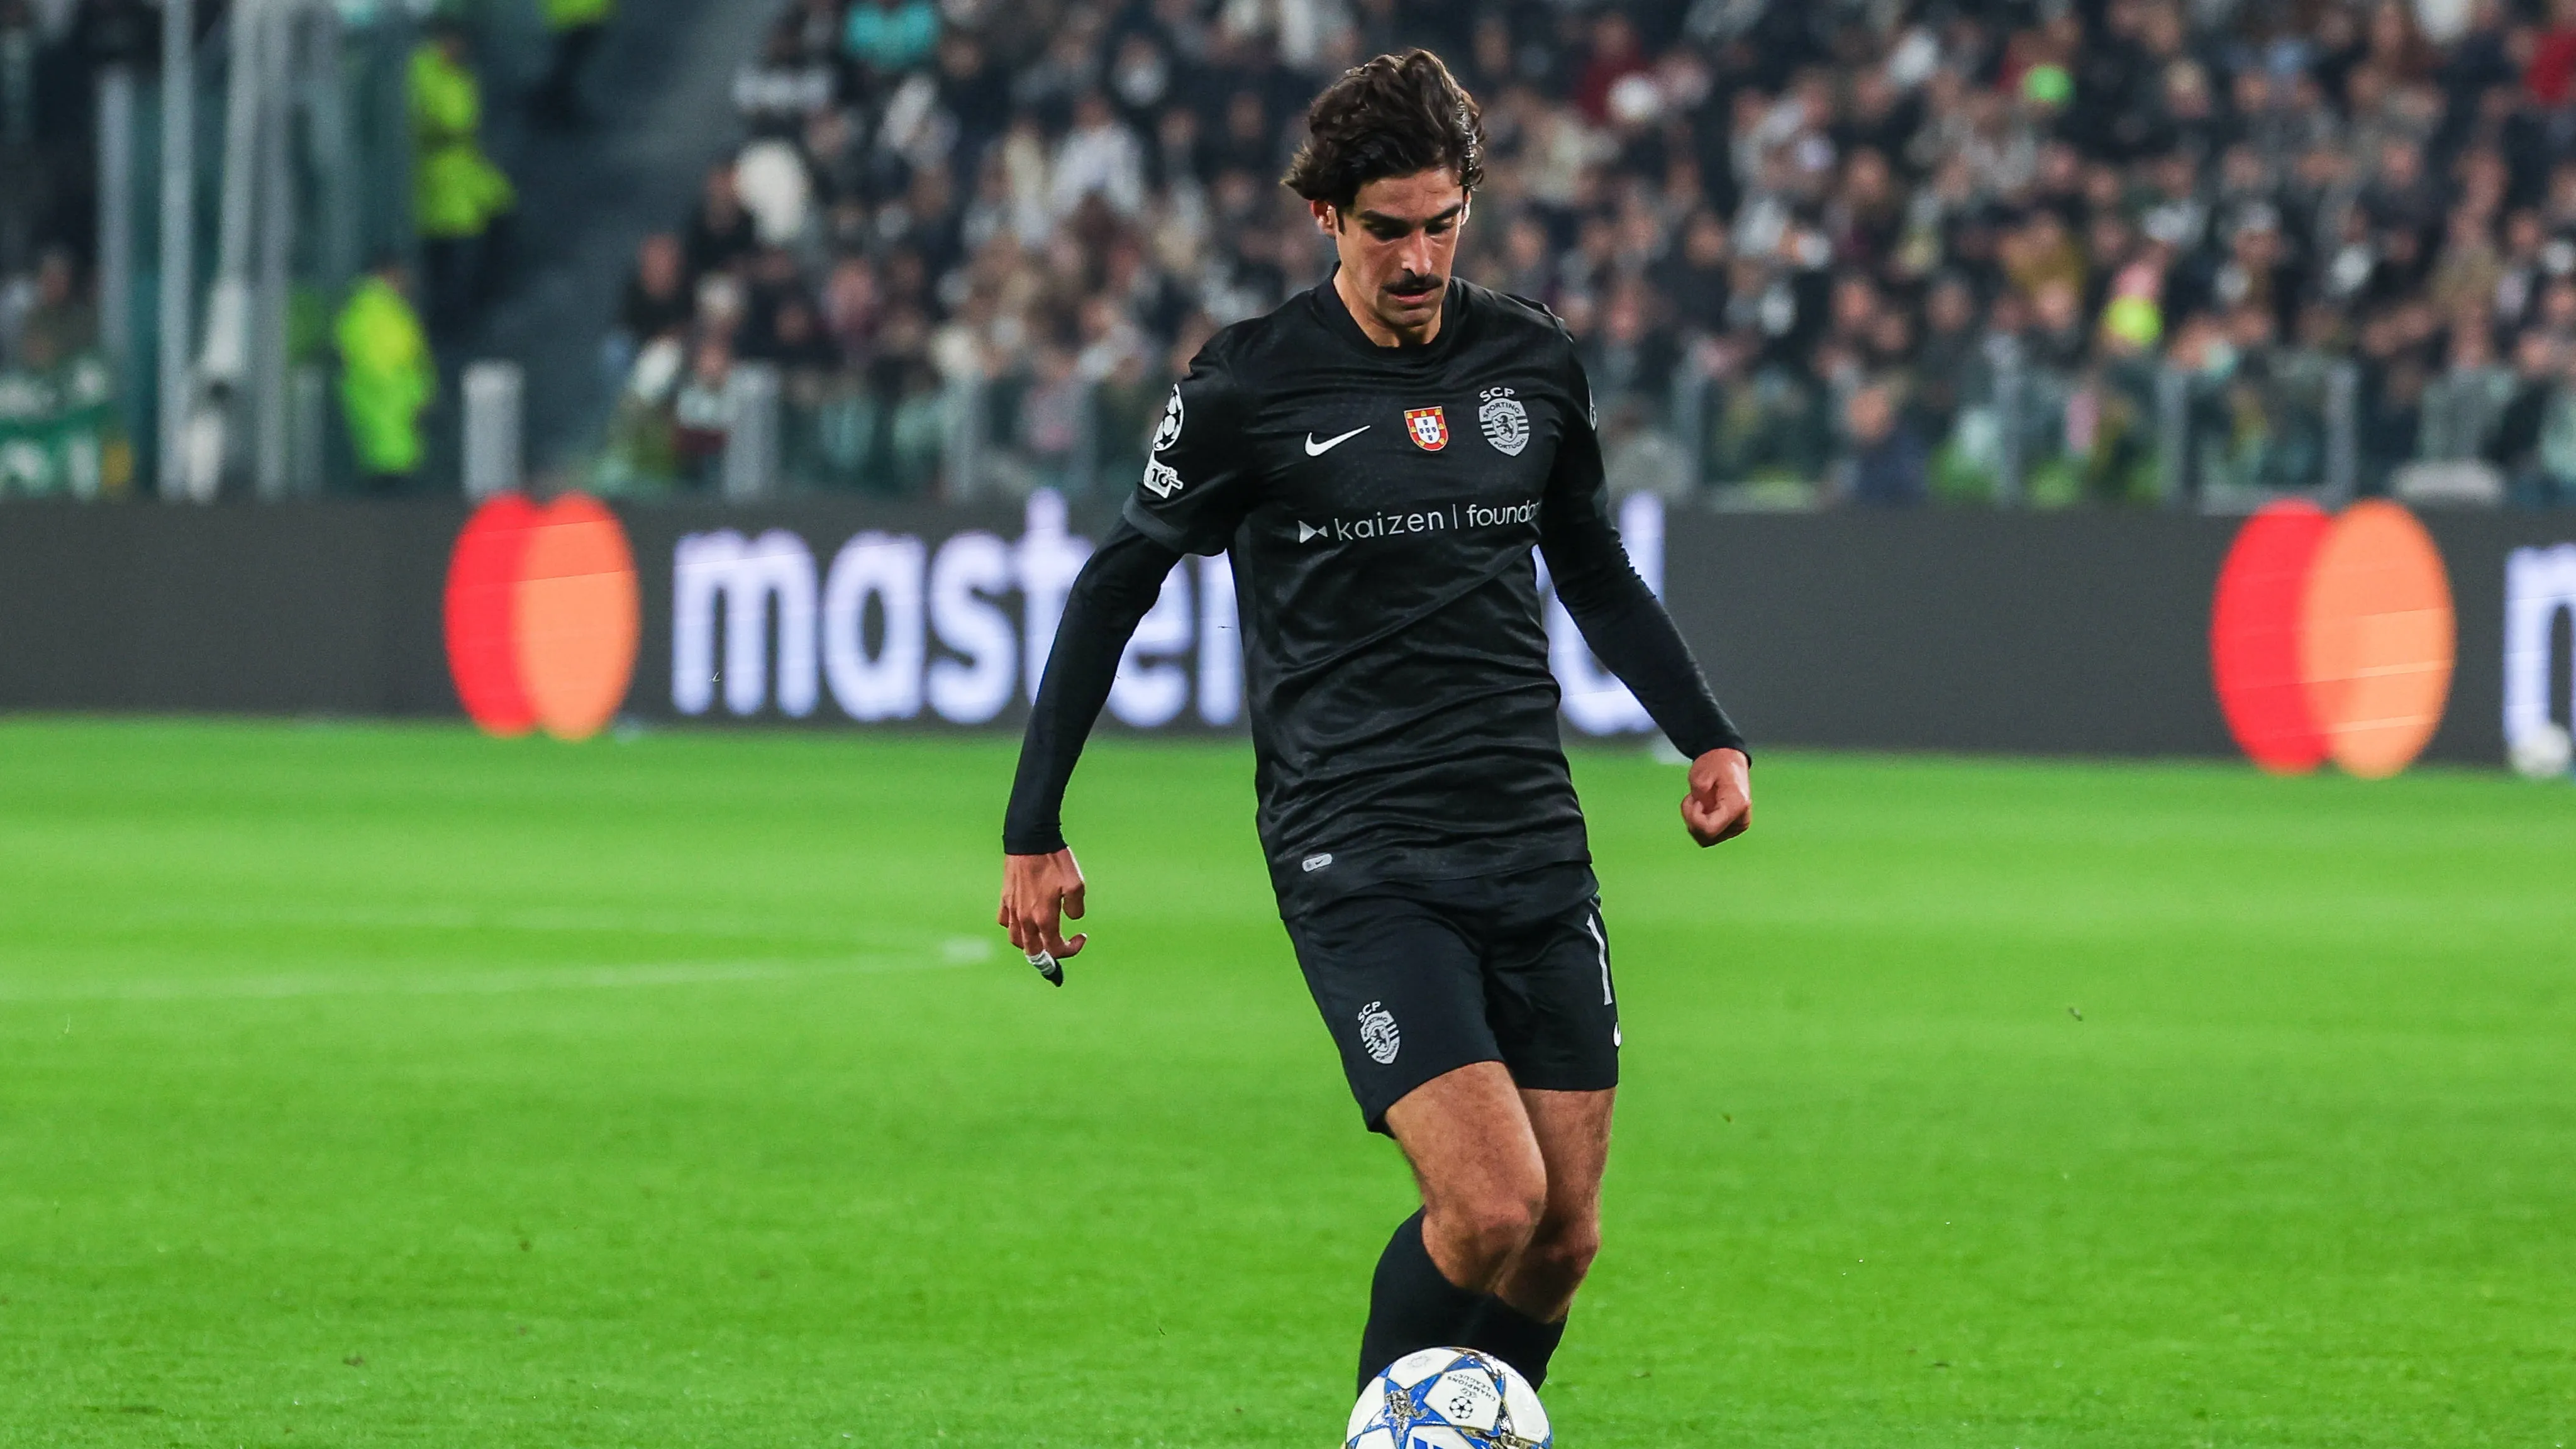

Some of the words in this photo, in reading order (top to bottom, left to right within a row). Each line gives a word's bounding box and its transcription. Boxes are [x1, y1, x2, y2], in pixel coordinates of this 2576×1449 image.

[1479, 387, 1515, 402] SCP
[1484, 402, 1521, 419] SPORTING
[1334, 511, 1445, 541] kaizen
[1466, 500, 1540, 527] founda
[1358, 1001, 1381, 1023] SCP
[1447, 1376, 1496, 1402] CHAMPIONS
